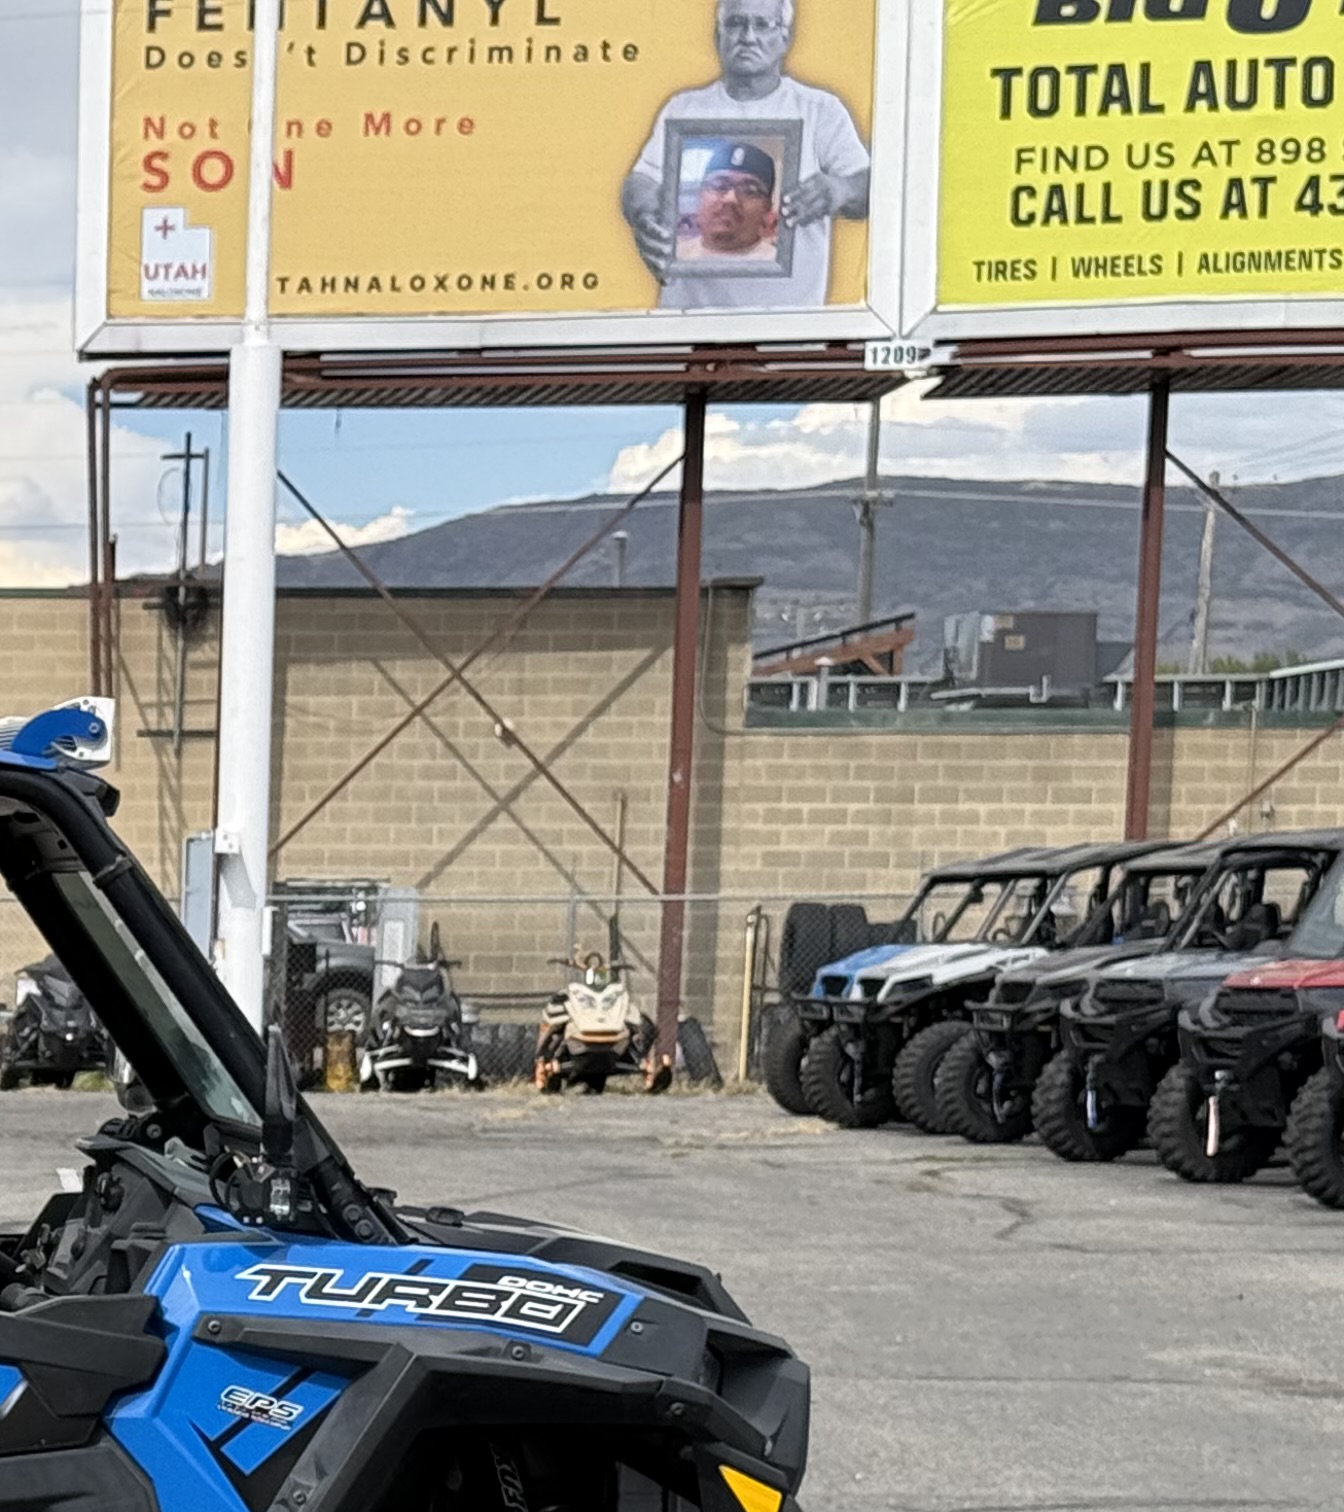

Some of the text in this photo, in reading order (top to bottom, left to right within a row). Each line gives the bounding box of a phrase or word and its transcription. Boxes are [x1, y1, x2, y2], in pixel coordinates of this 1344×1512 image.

[145, 37, 639, 69] Does't Discriminate
[990, 55, 1335, 120] TOTAL AUTO
[142, 111, 476, 140] Not ne More
[1014, 136, 1327, 174] FIND US AT 898
[1011, 181, 1123, 227] CALL
[1140, 177, 1202, 222] US
[1219, 175, 1278, 219] AT
[143, 262, 206, 281] UTAH
[276, 272, 600, 294] TAHNALOXONE.ORG
[973, 248, 1343, 283] TIRES WHEELS ALIGNMENTS
[235, 1263, 586, 1334] TURBO
[497, 1275, 605, 1304] DOHC
[220, 1384, 305, 1422] EPS
